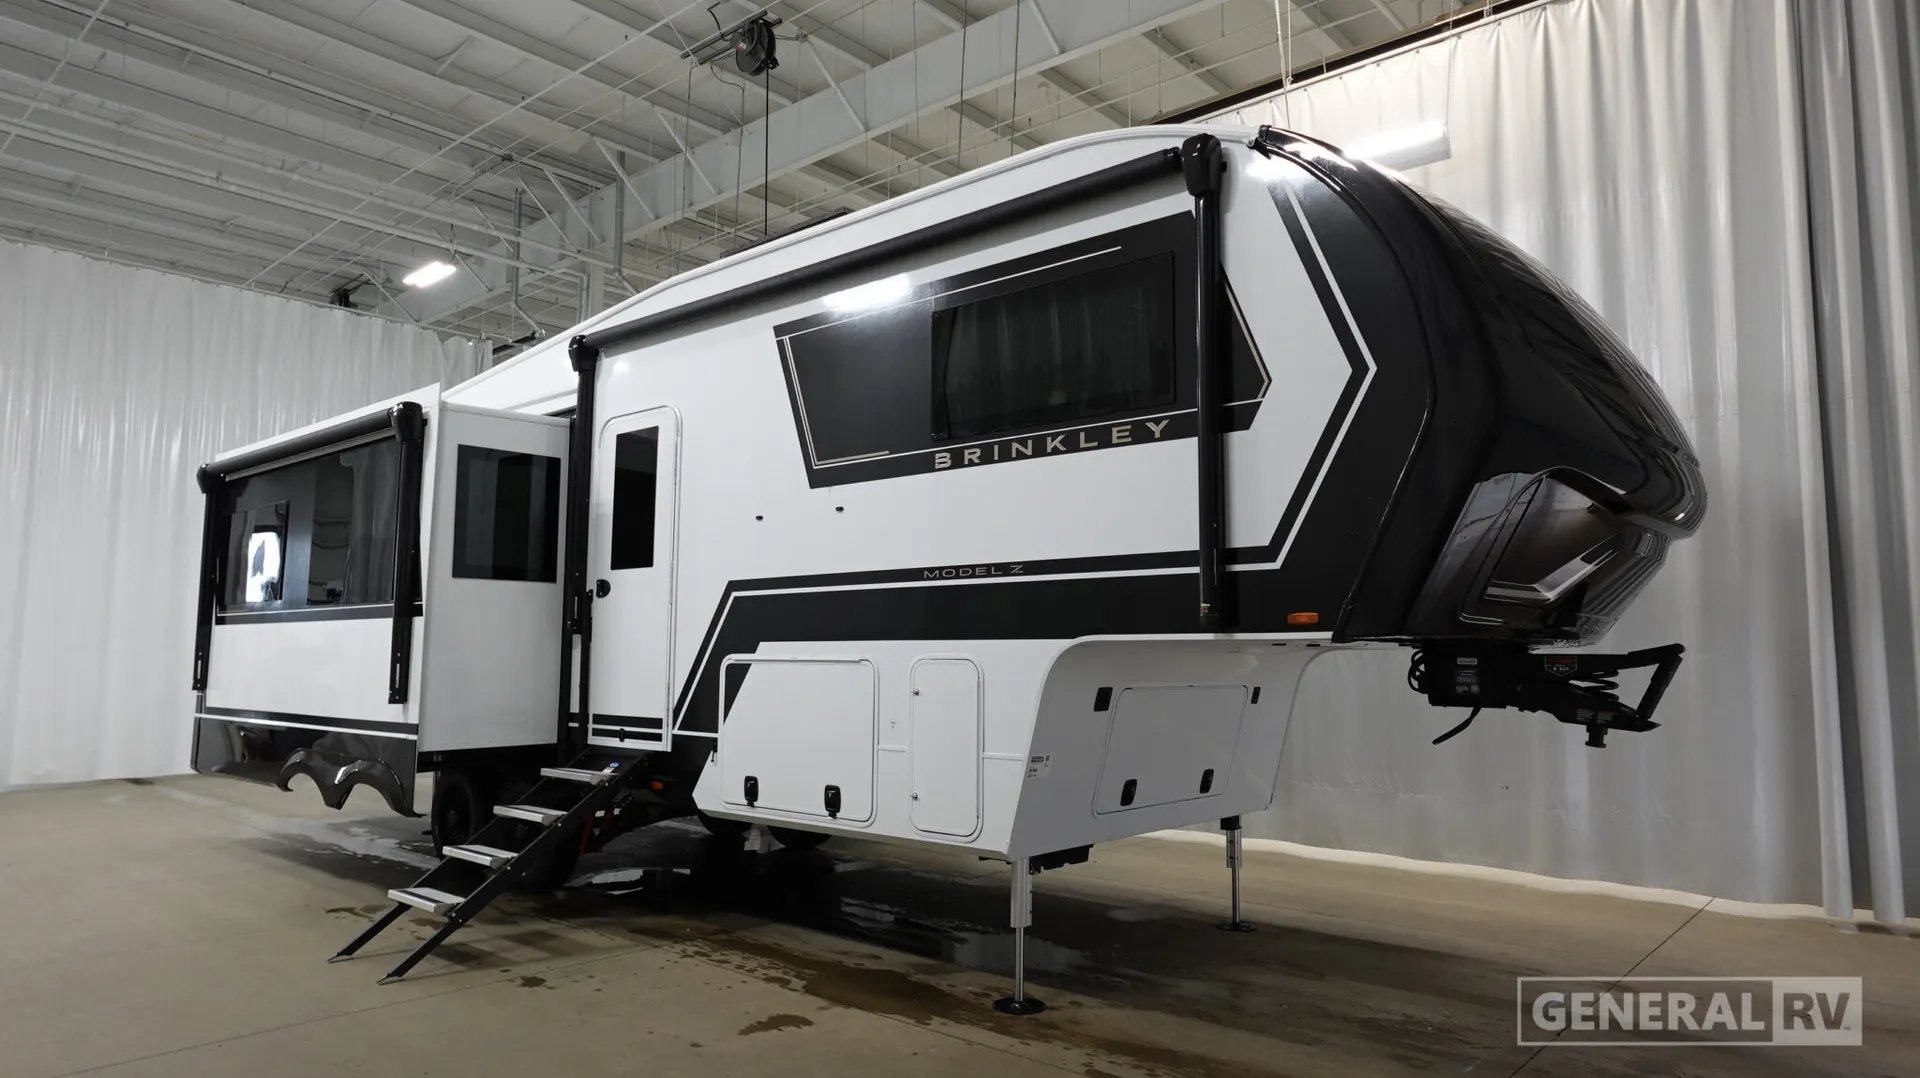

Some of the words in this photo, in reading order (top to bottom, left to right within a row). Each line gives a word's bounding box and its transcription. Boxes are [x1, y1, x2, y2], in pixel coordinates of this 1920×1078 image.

[934, 419, 1170, 469] BRINKLEY
[923, 566, 1003, 579] MODEL
[1010, 565, 1024, 574] Z
